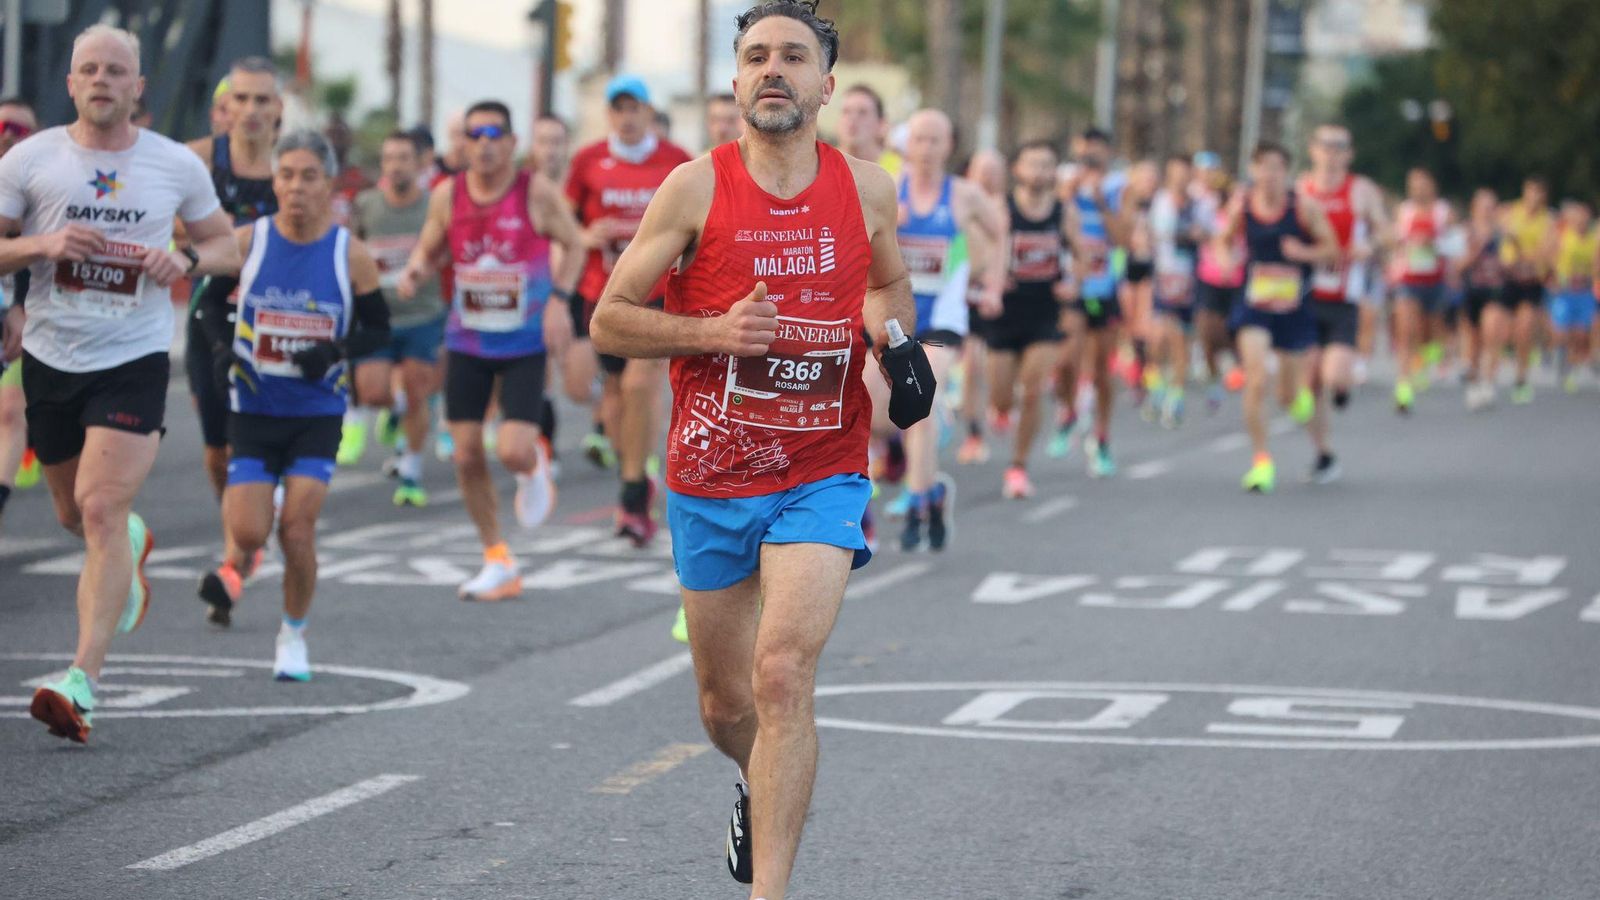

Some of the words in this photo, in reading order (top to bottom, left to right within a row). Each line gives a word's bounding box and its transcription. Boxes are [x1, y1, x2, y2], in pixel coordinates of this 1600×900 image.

[66, 205, 147, 224] SAYSKY
[769, 207, 799, 216] luanvi
[754, 227, 813, 242] GENERALI
[783, 246, 813, 256] MARATÓN
[71, 261, 125, 285] 15700
[754, 254, 816, 276] MÁLAGA
[766, 357, 823, 381] 7368
[775, 380, 810, 391] ROSARIO
[810, 403, 826, 411] 42K
[1175, 547, 1568, 586] RED
[970, 573, 1600, 622] ASICA
[942, 690, 1419, 741] 50
